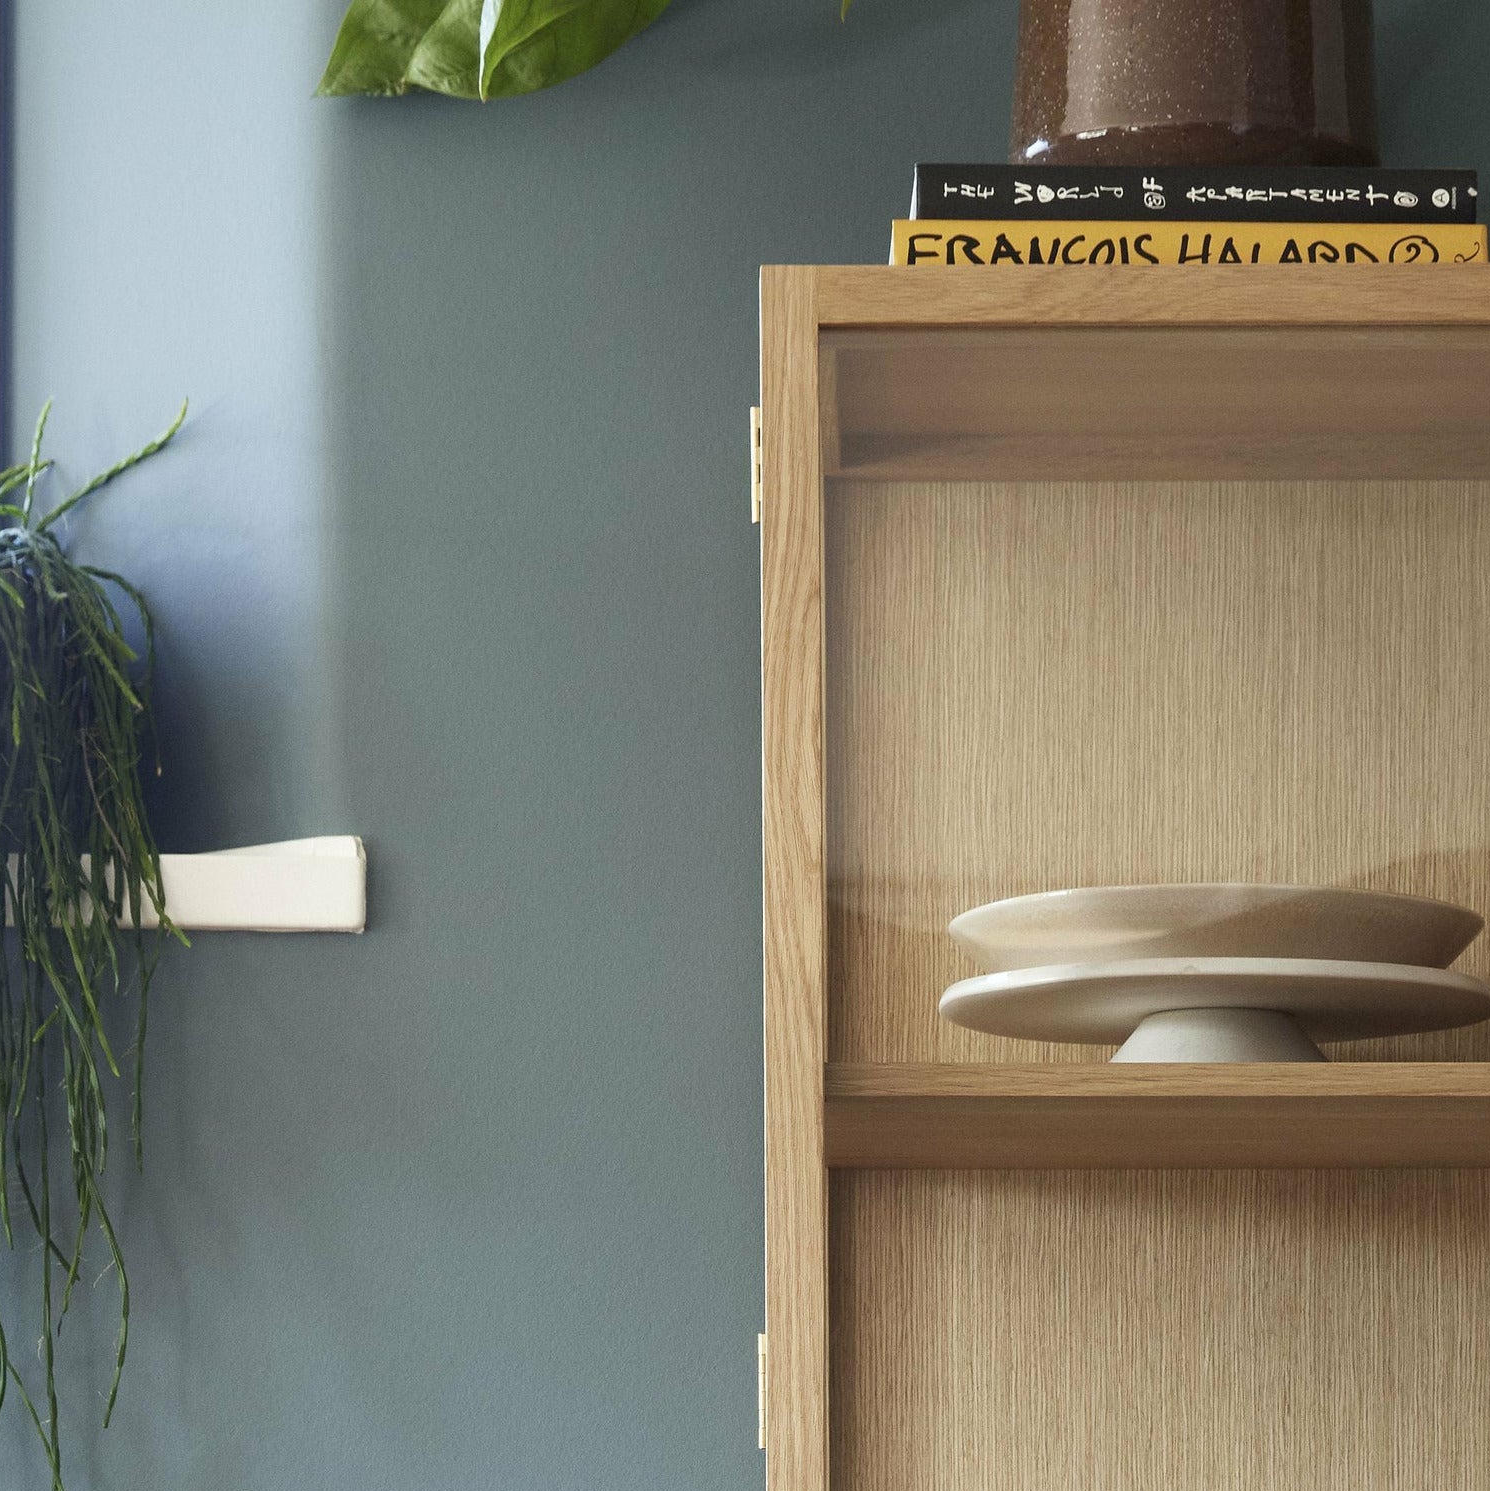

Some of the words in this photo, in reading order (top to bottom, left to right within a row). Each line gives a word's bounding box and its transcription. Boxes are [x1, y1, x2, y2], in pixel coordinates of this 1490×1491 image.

[944, 182, 995, 199] THE
[1142, 176, 1166, 209] OF
[1186, 184, 1419, 208] APARTAMENTO
